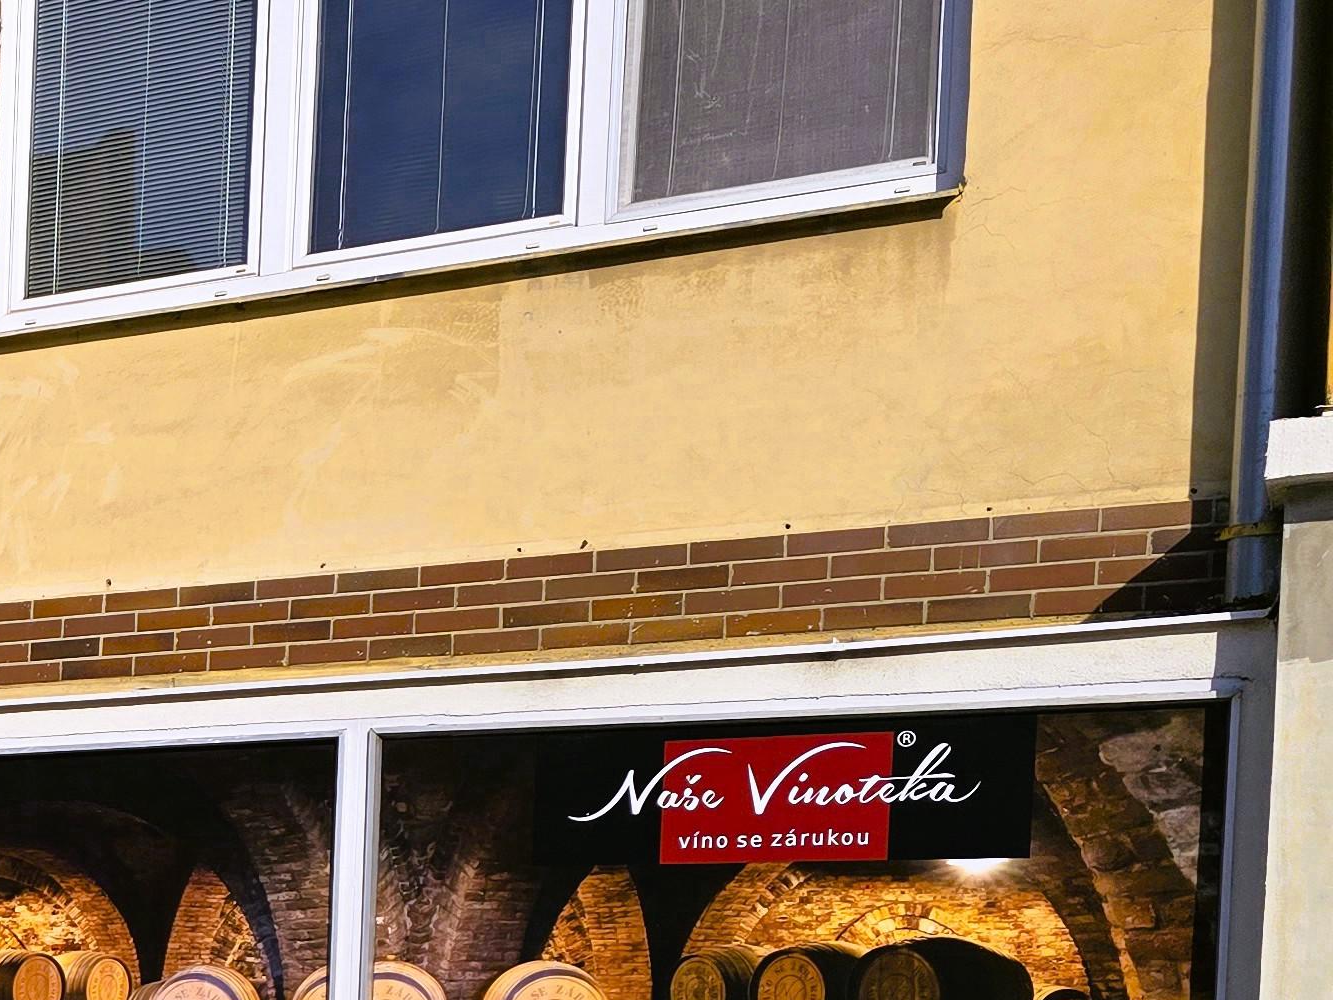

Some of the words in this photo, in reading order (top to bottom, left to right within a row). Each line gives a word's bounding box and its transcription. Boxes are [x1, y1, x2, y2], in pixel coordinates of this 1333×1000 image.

[568, 747, 733, 822] Naše
[748, 741, 981, 815] Vinoteka
[678, 831, 728, 850] víno
[736, 834, 763, 849] se
[771, 828, 870, 848] zárukou
[530, 986, 548, 1000] SE
